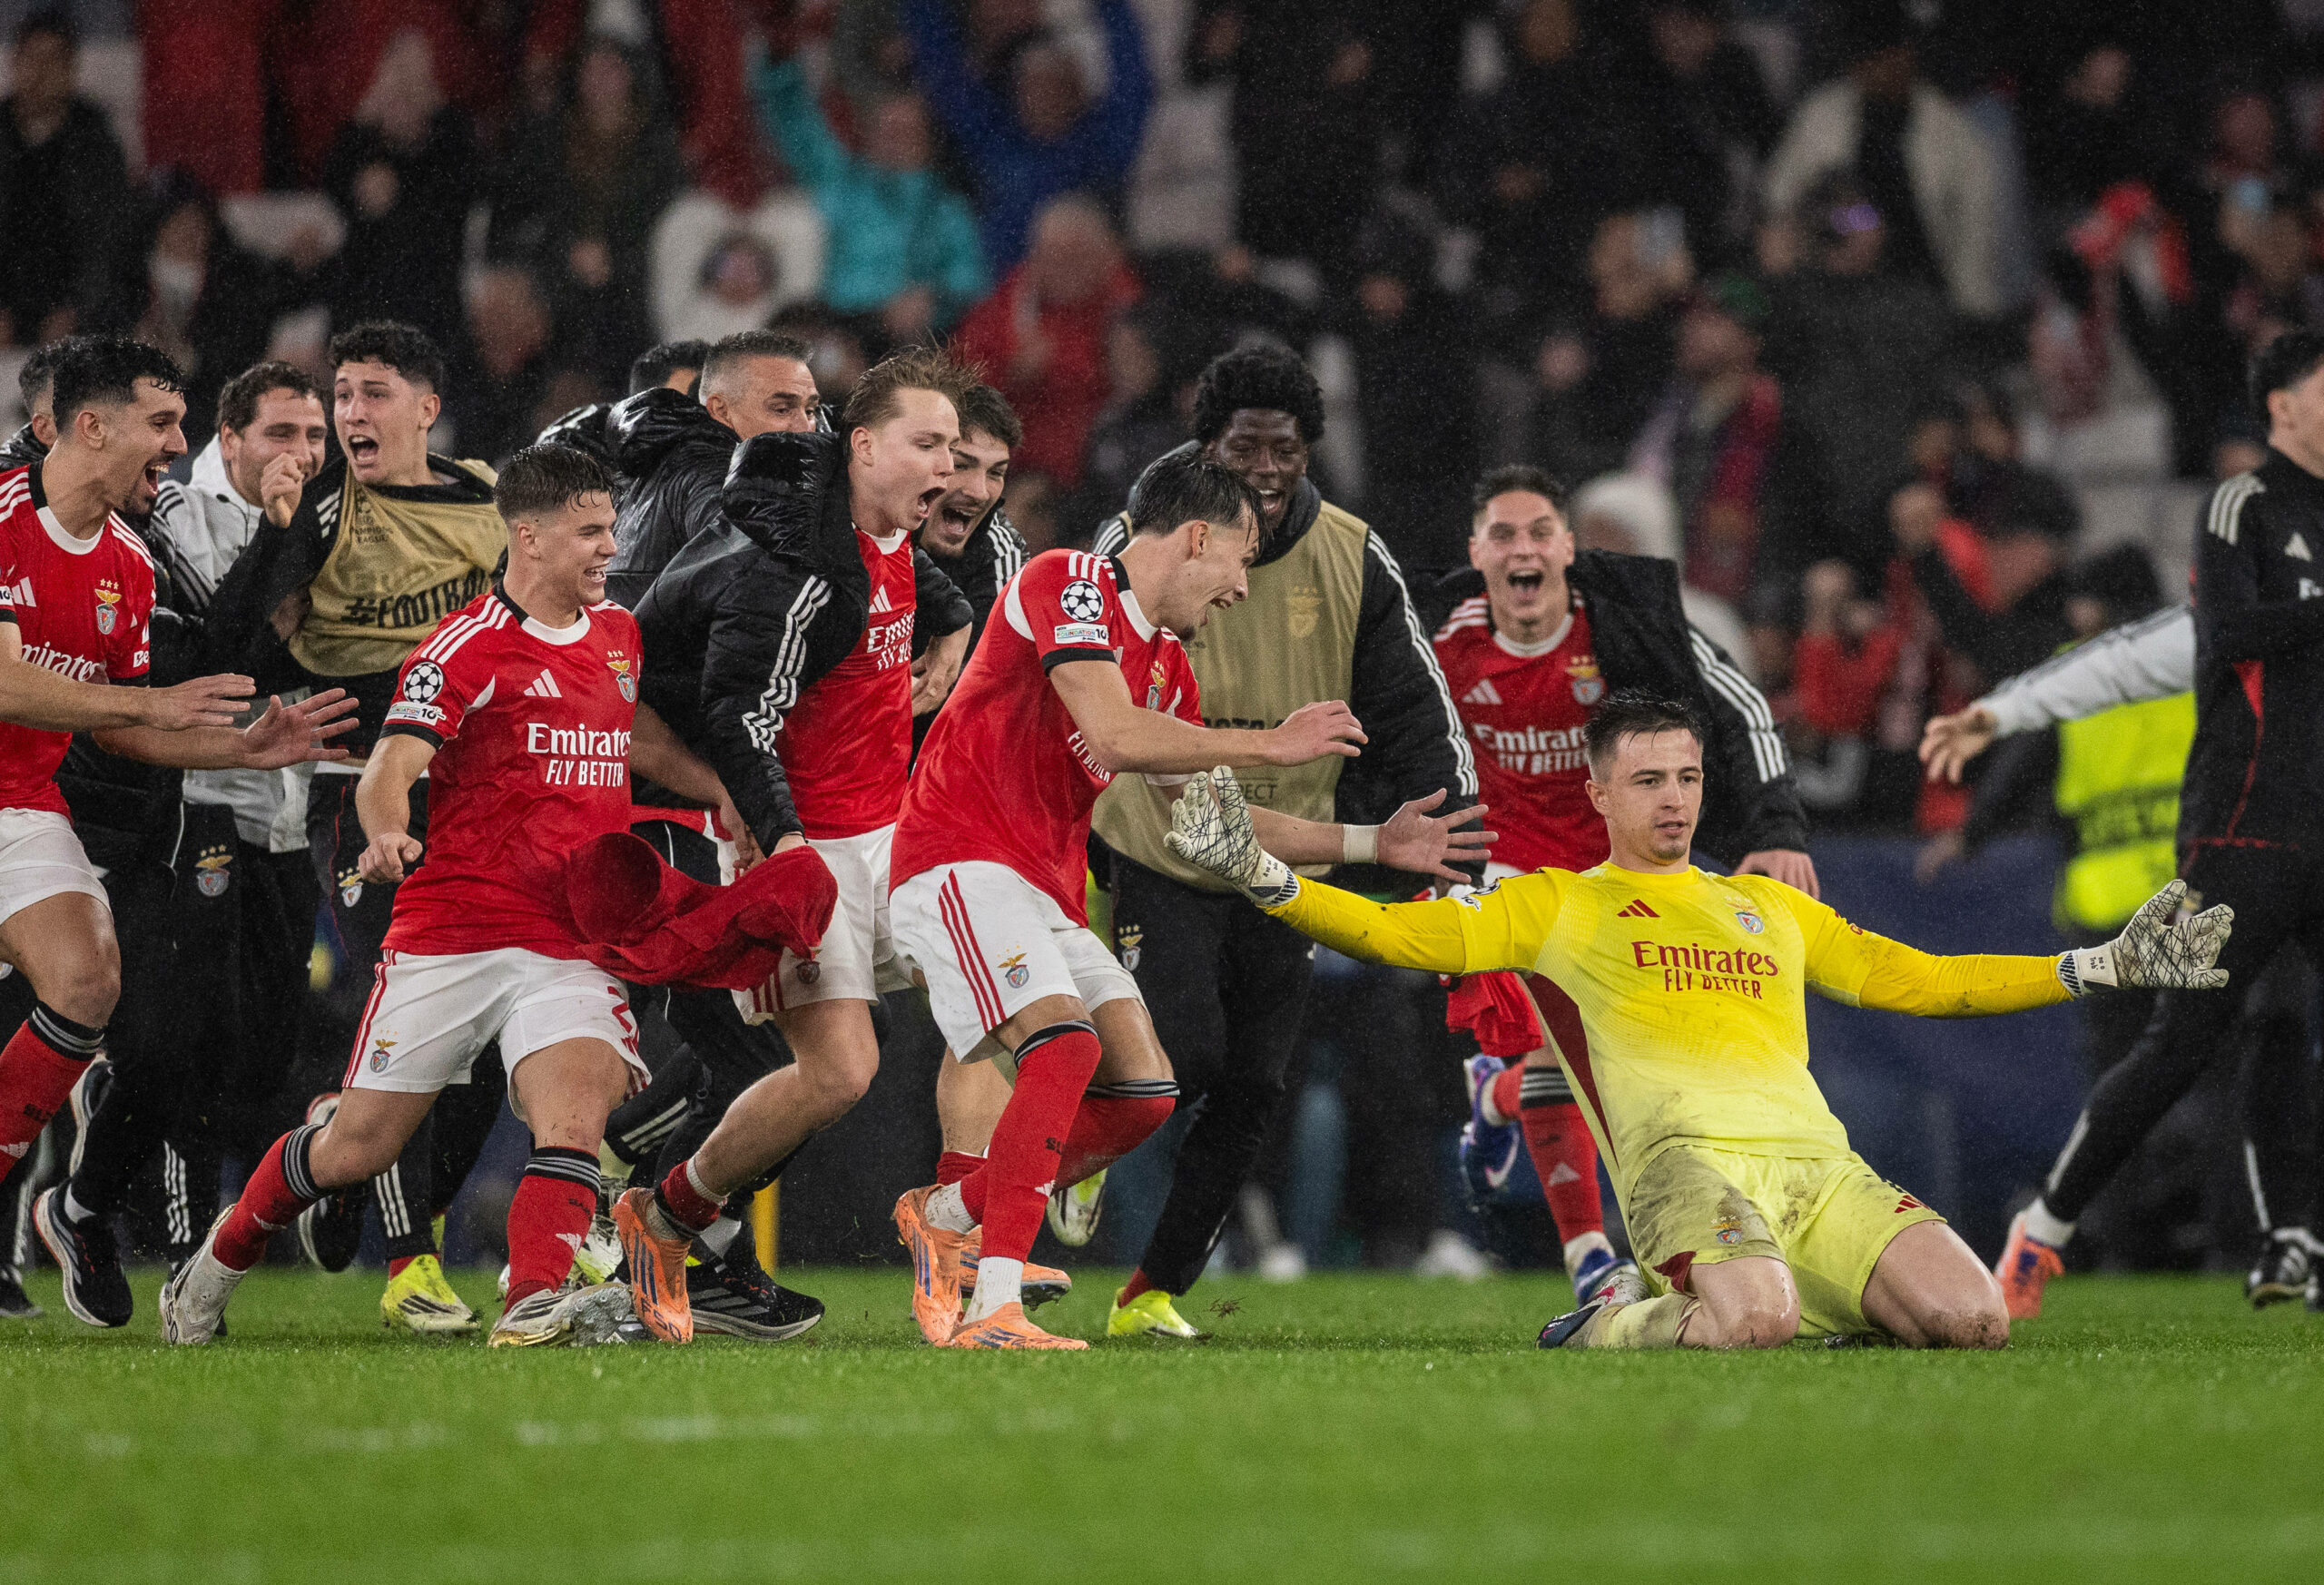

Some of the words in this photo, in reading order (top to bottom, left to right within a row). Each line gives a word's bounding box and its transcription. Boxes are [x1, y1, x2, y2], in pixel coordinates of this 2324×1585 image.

[546, 759, 575, 785] FLY
[578, 760, 624, 787] BETTER
[1631, 940, 1778, 977] Emirates
[1664, 969, 1692, 992] FLY
[1701, 974, 1762, 999] BETTER
[640, 1297, 683, 1343] F50
